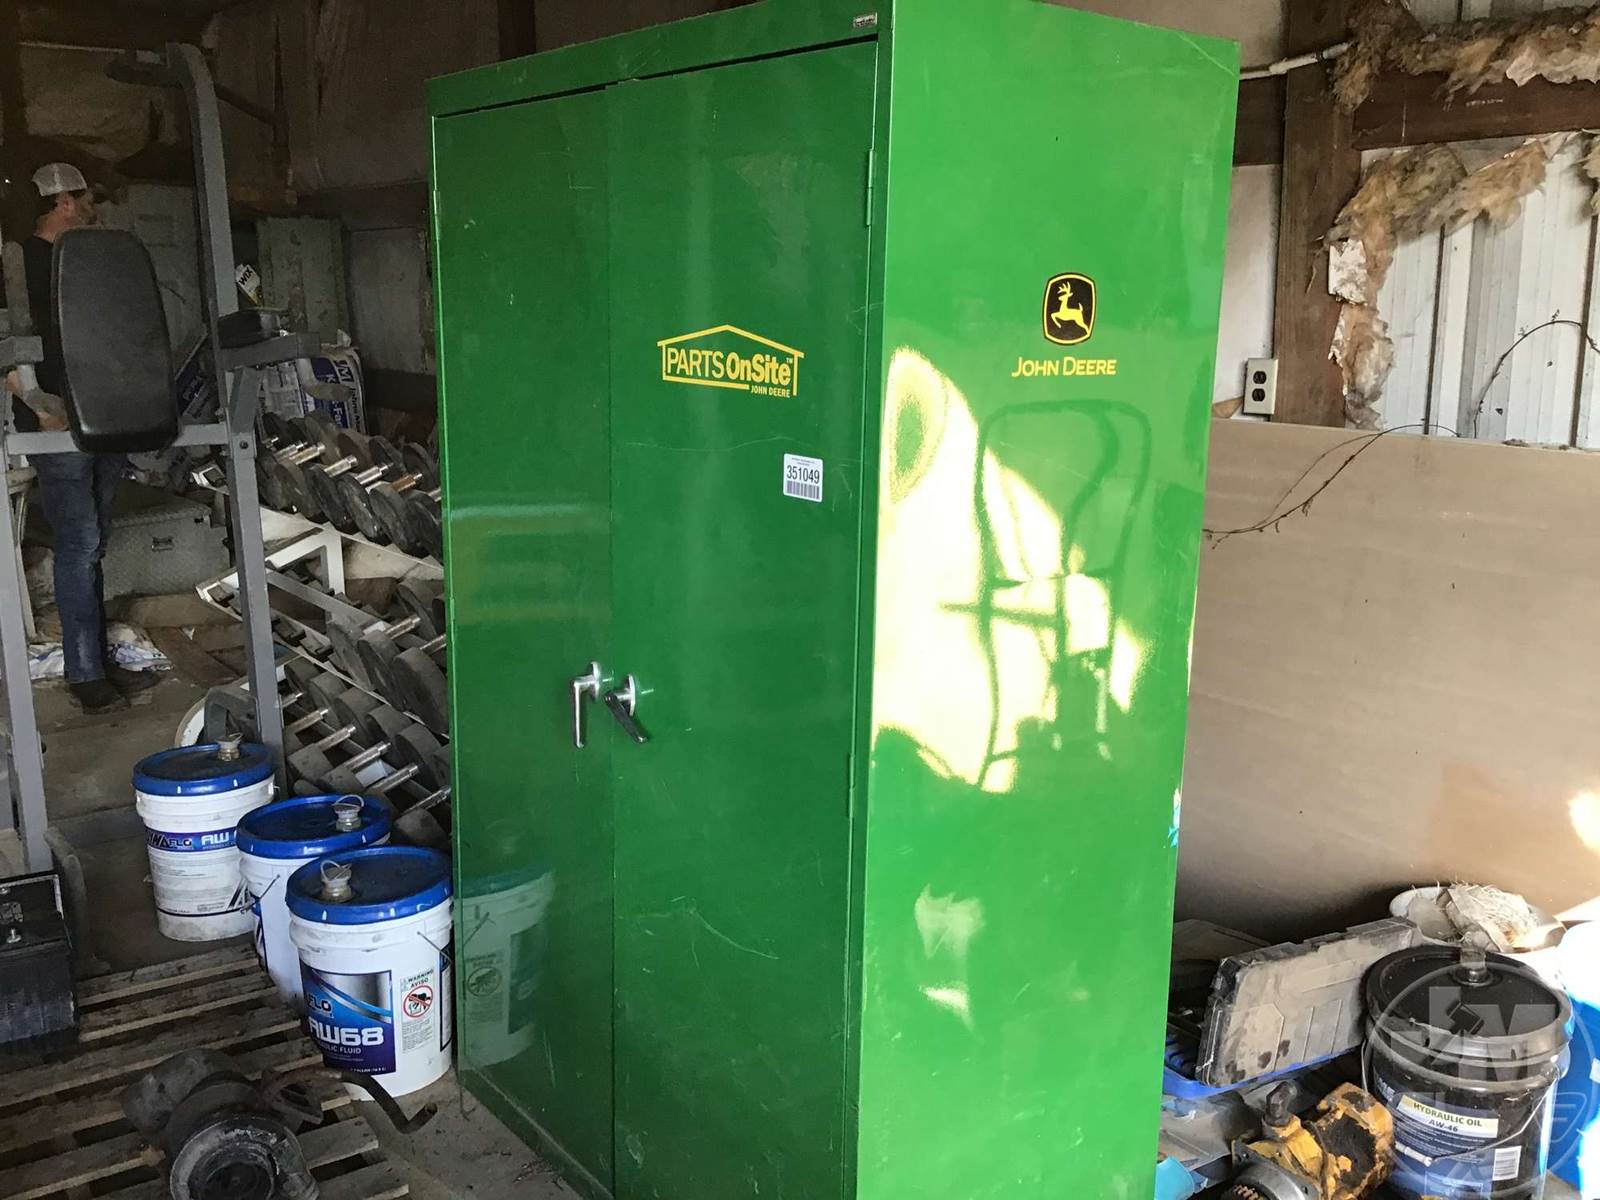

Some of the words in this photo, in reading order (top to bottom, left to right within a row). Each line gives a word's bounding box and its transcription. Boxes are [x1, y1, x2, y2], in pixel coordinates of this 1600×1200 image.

[238, 266, 253, 286] WIX
[1011, 356, 1060, 377] JOHN
[1062, 356, 1117, 376] DEERE
[750, 385, 768, 395] JOHN
[768, 387, 791, 399] DEERE
[786, 464, 820, 484] 351049
[308, 1015, 384, 1046] AW68
[339, 1047, 362, 1055] FLUID
[1413, 1101, 1464, 1125] HYDRAULIC
[1466, 1117, 1483, 1127] OIL
[1428, 1118, 1459, 1132] AW-46
